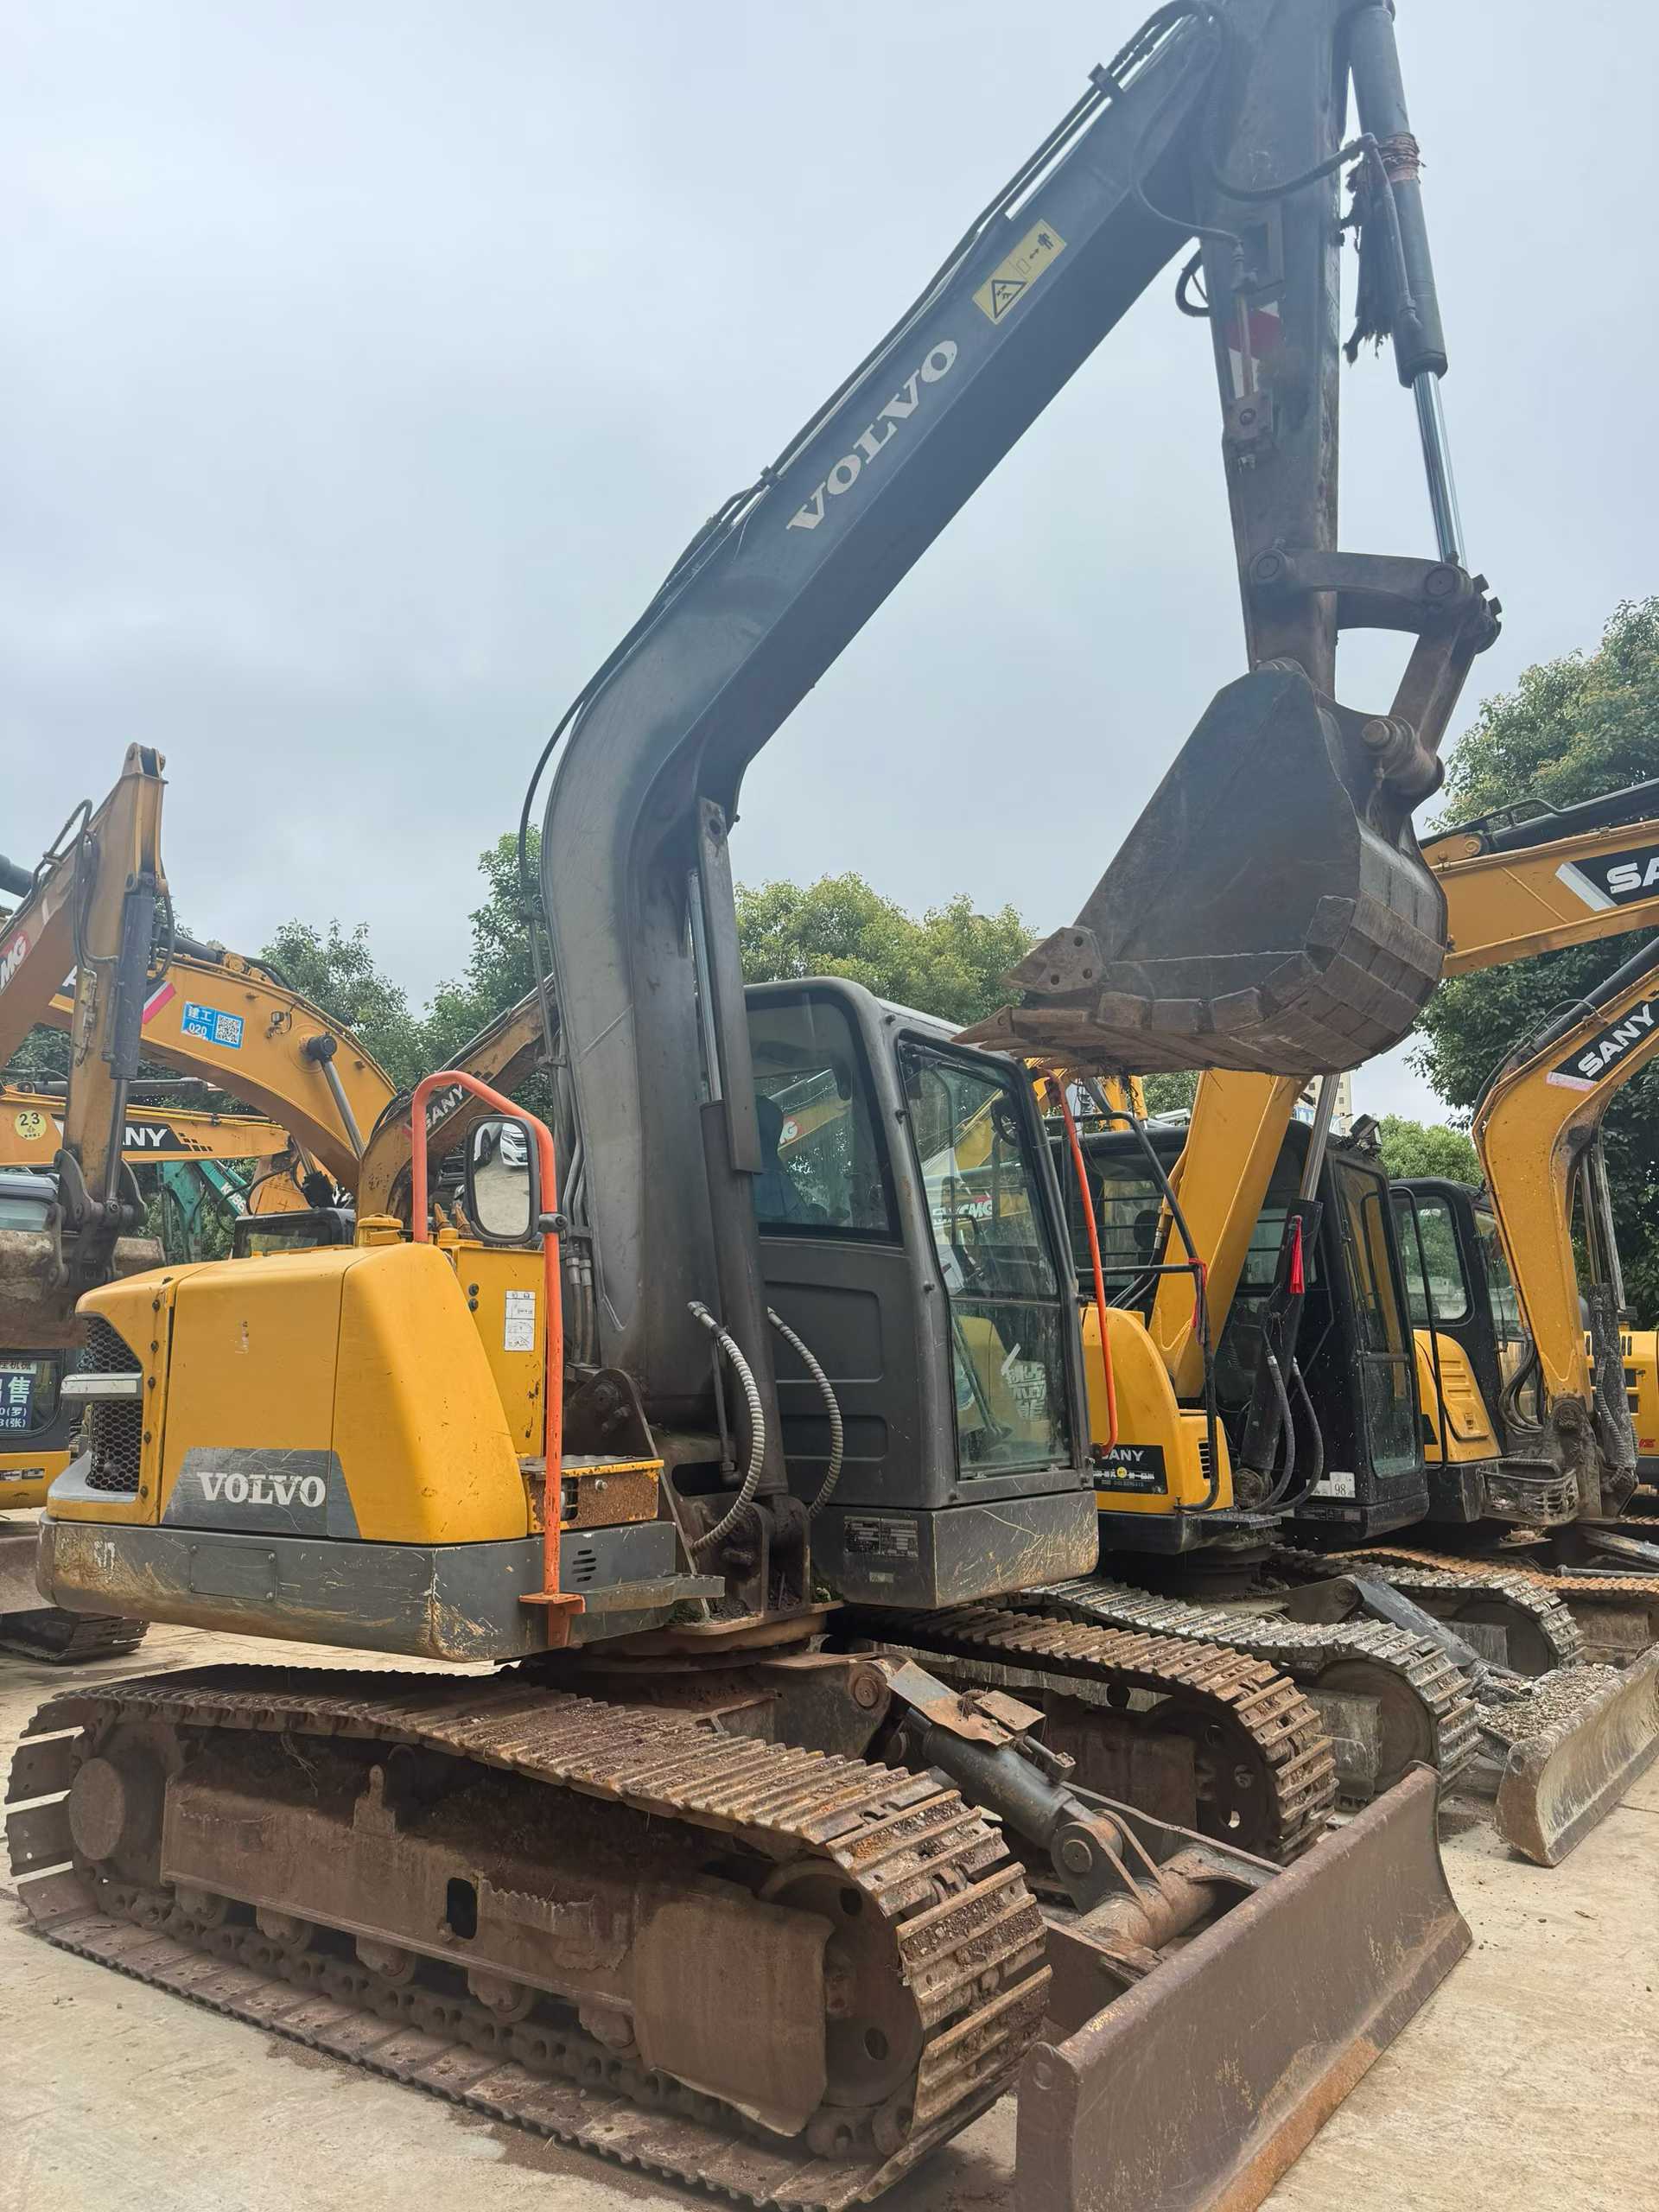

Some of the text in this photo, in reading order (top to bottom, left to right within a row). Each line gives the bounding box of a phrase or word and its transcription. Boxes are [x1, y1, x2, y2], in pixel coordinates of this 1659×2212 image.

[785, 340, 957, 530] VOLVO
[188, 1023, 207, 1035] 020
[1578, 1003, 1655, 1077] SANY
[19, 1112, 41, 1127] 23
[123, 1127, 168, 1147] NY
[0, 1376, 31, 1404] 售
[1102, 1448, 1145, 1462] ANY
[196, 1471, 327, 1507] VOLVO
[1334, 1483, 1346, 1496] 98
